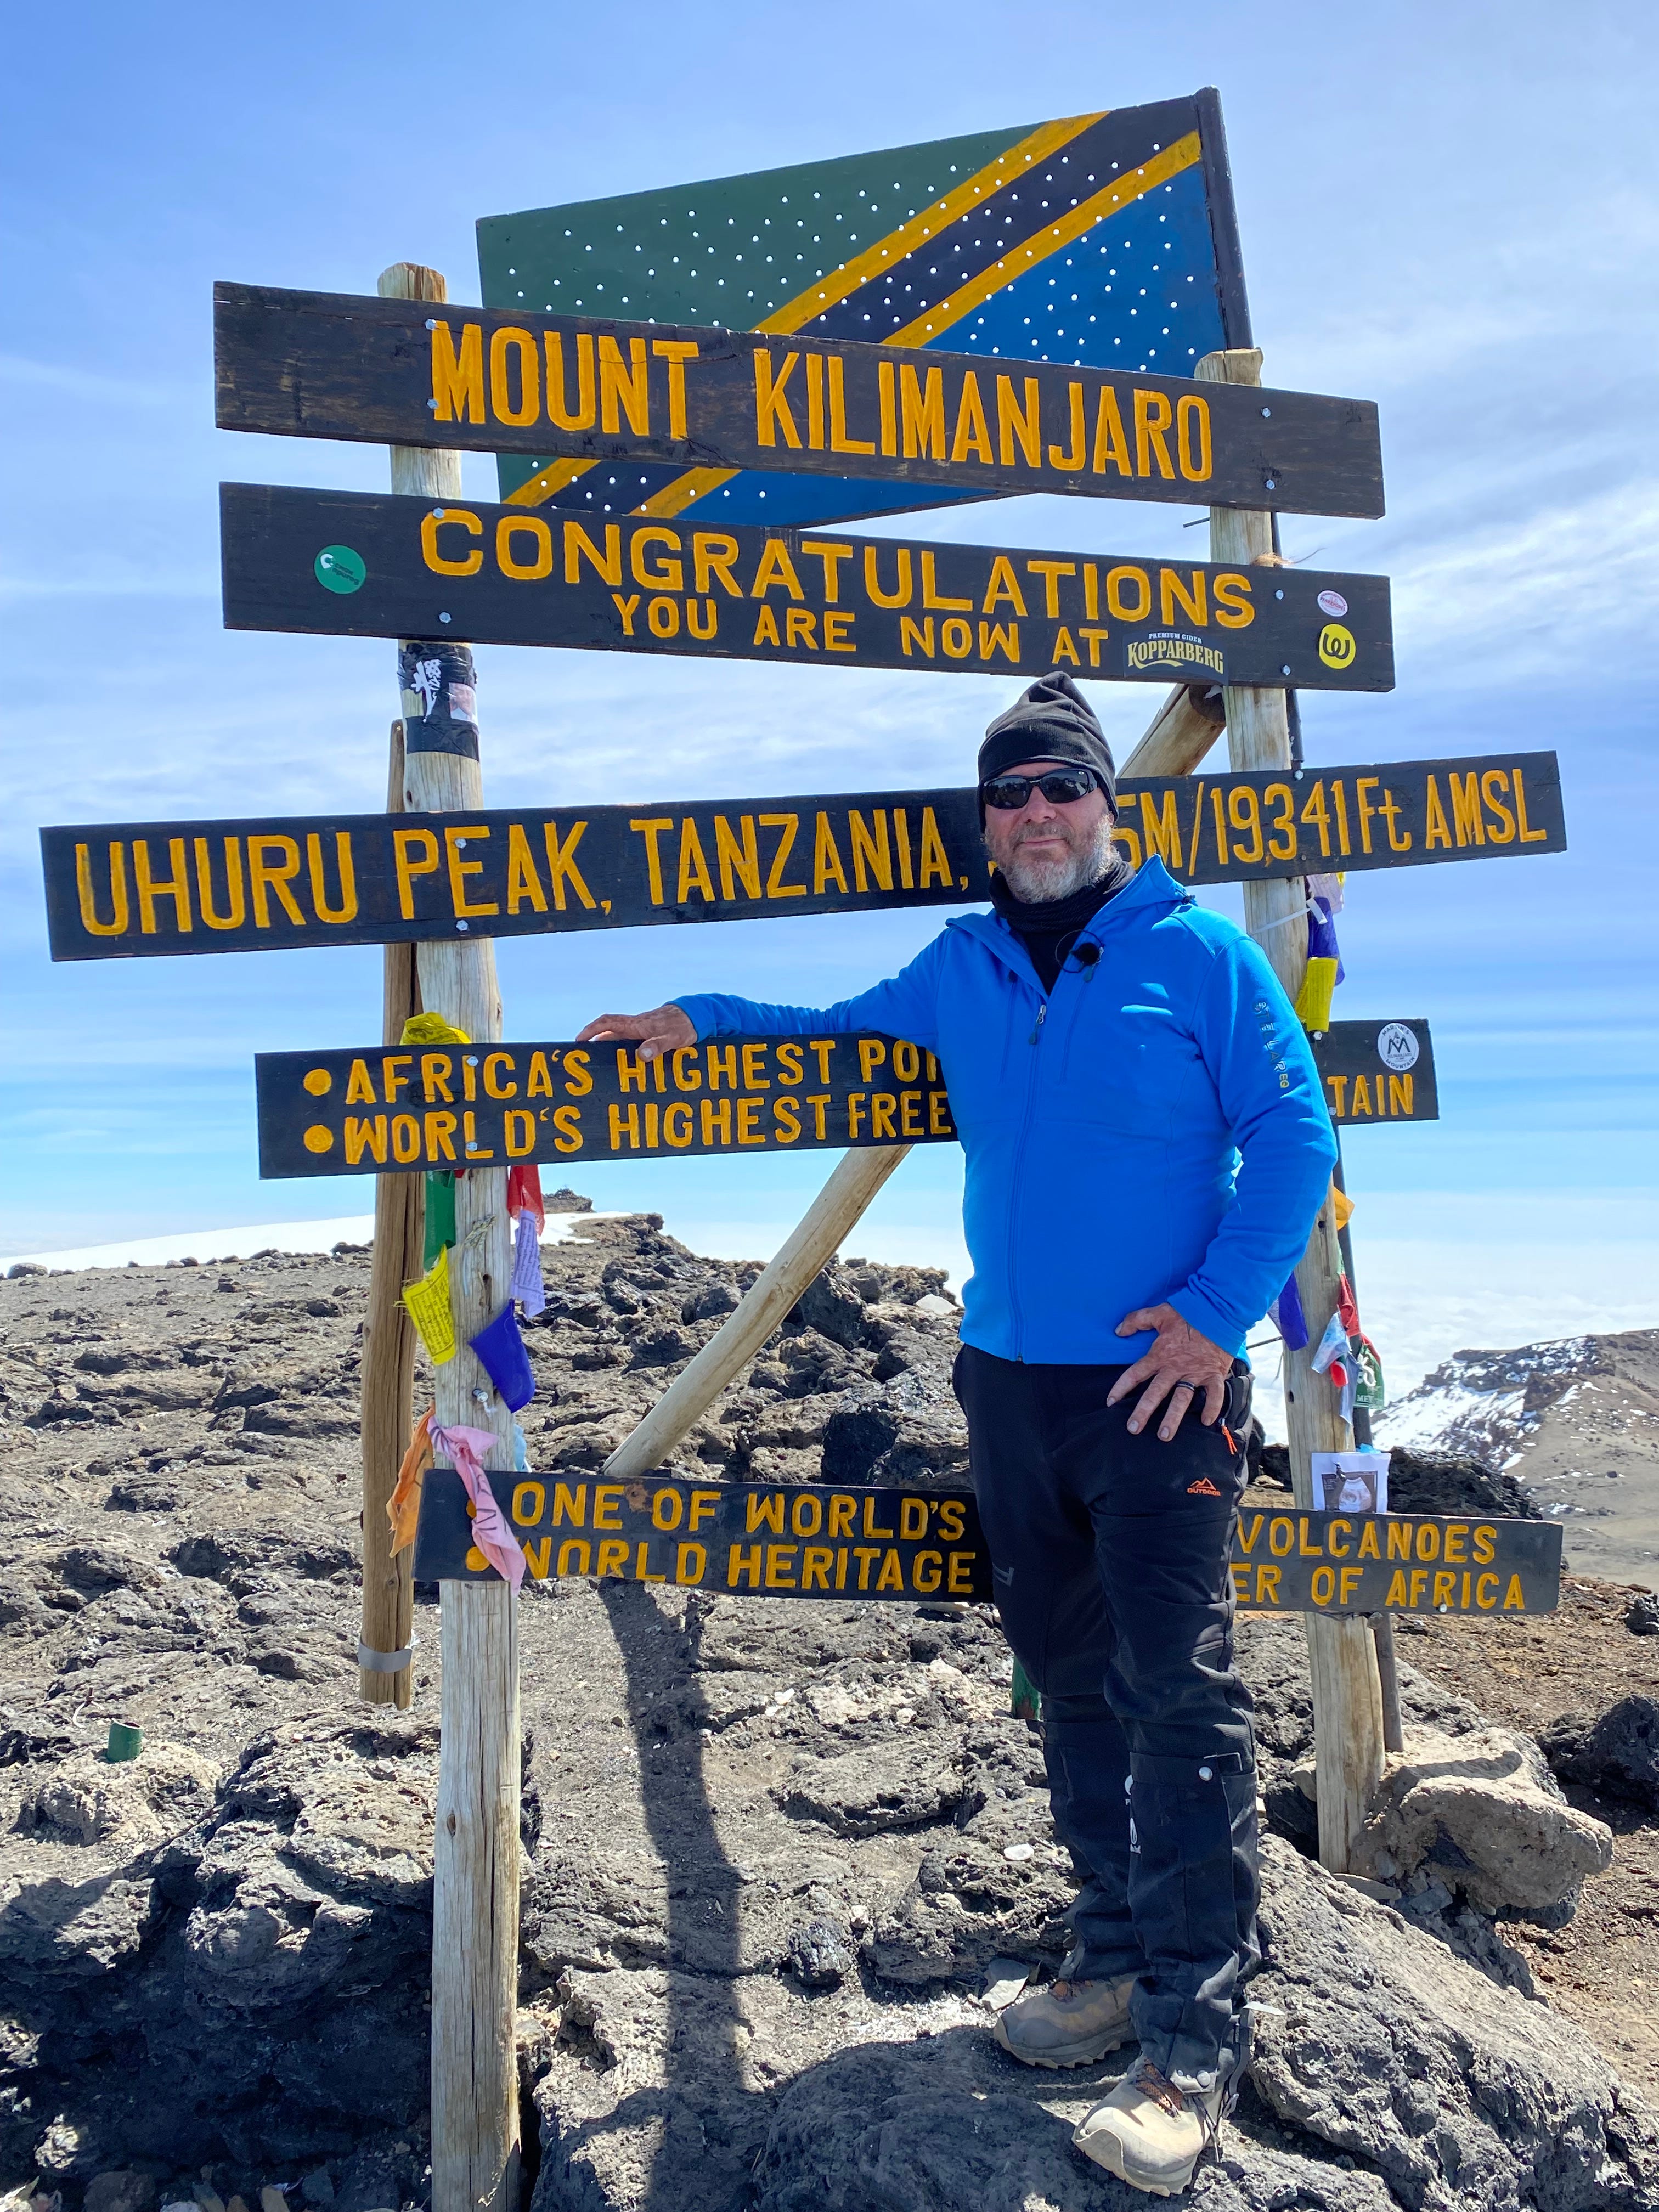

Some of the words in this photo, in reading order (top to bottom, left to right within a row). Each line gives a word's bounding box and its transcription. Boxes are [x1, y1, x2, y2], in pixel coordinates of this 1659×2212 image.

[431, 320, 699, 440] MOUNT
[753, 348, 1213, 482] KILIMANJARO
[420, 509, 1256, 629] CONGRATULATIONS
[611, 592, 718, 640] YOU
[753, 605, 856, 652] ARE
[900, 616, 1020, 662] NOW
[1052, 627, 1108, 667] AT
[1127, 640, 1224, 674] KOPPARBERG
[1182, 634, 1203, 644] CIDER
[75, 832, 358, 936] UHURU
[393, 821, 612, 919] PEAK,
[629, 806, 968, 905] TANZANIA,
[1426, 770, 1547, 850] AMSL
[346, 1049, 593, 1104] AFRICA'S
[617, 1040, 835, 1093] HIGHEST
[1386, 1056, 1415, 1069] MOUNTAIN
[344, 1105, 583, 1164] WORLD'S
[608, 1094, 831, 1150] HIGHEST
[848, 1091, 952, 1138] FREE
[1327, 1073, 1414, 1117] TAIN
[512, 1481, 625, 1530] ONE
[652, 1488, 721, 1531] OF
[746, 1491, 966, 1541] WORLD'S
[1237, 1514, 1497, 1565] VOLCANOES
[1187, 1487, 1221, 1497] OUTDOOR
[727, 1544, 976, 1593] HERITAGE
[1311, 1566, 1364, 1606] OF
[1385, 1569, 1525, 1610] AFRICA
